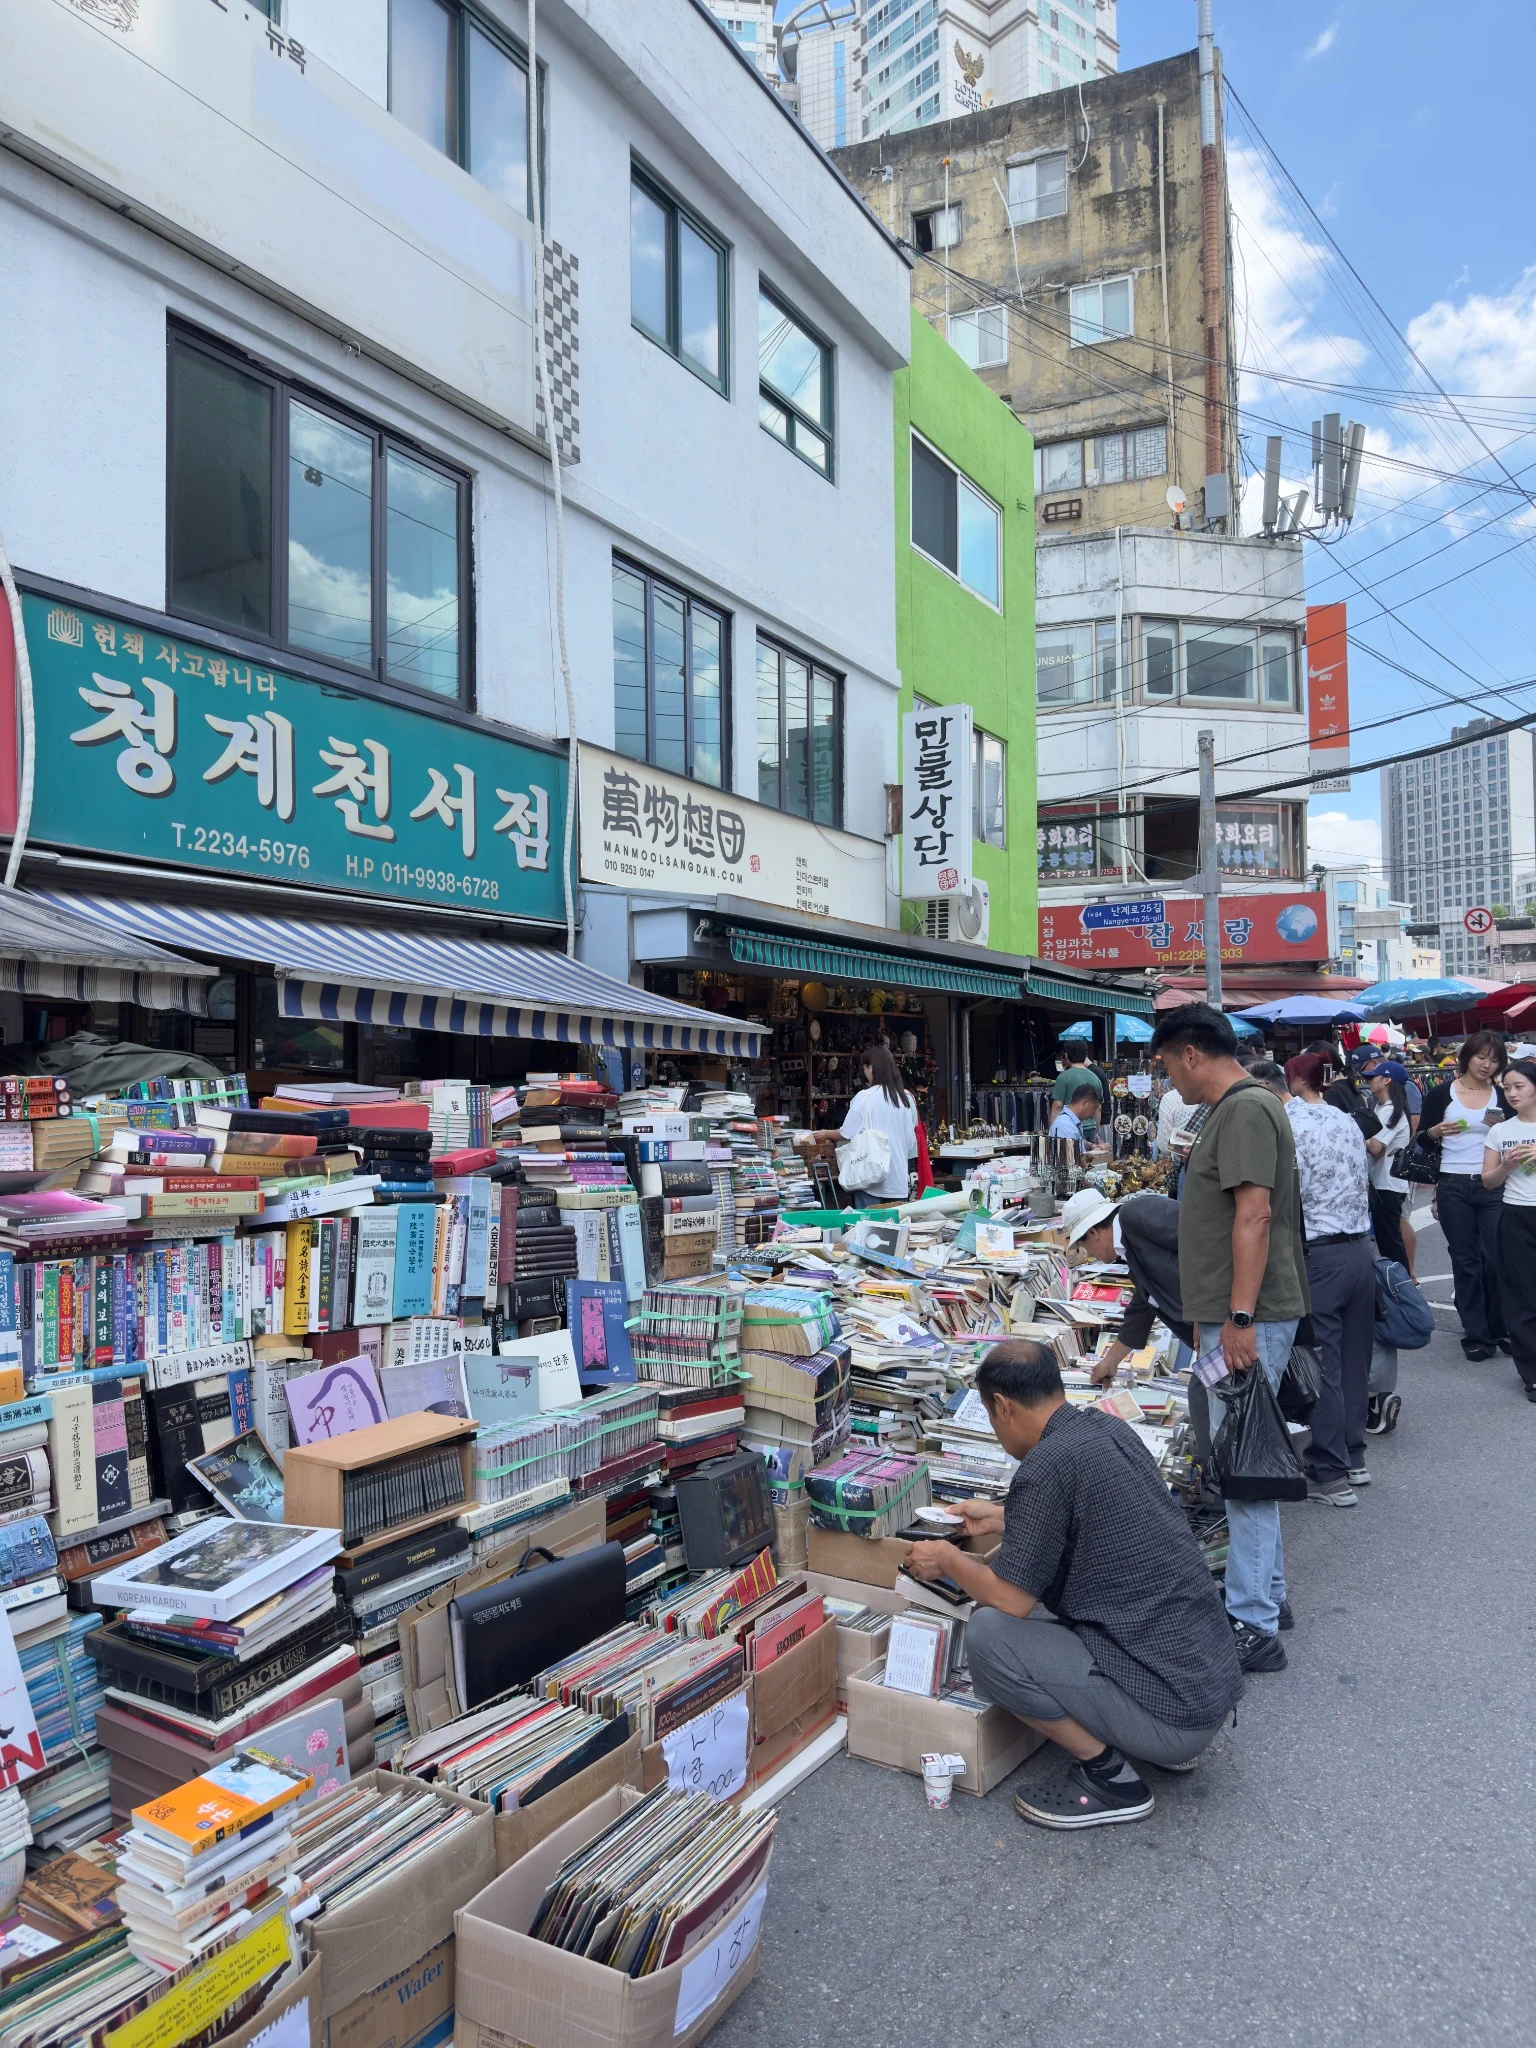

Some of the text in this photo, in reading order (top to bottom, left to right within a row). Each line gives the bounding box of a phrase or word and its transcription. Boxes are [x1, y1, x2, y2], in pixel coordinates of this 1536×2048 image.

[92, 622, 277, 701] 헌책 사고팝니다
[70, 672, 550, 872] 청계천서점
[1312, 780, 1349, 789] 2232-2828
[910, 717, 954, 866] 만물상단
[172, 822, 311, 870] T.2234-5976
[604, 841, 743, 884] MANMOOLSANGDAN.COM
[346, 853, 499, 900] H.P 011-9938-6728
[605, 859, 655, 879] 010 9253 0147
[1103, 915, 1162, 926] Nangye-ro 25-gil
[1042, 938, 1093, 949] 수입과자
[1042, 947, 1119, 961] 건강기능식품
[61, 1282, 72, 1315] 동의보감
[97, 1270, 108, 1341] 동의보감
[46, 1289, 57, 1362] 산야초 백과사전
[117, 1591, 187, 1610] KOREAN GARDEN
[283, 1644, 307, 1665] PIANO
[776, 1624, 807, 1656] BOBBY
[284, 1653, 307, 1673] MUSIC
[235, 1658, 283, 1702] BACH
[227, 1819, 244, 1833] 규슈
[227, 1886, 239, 1896] 다섯
[158, 1952, 246, 2021] JOHANN SEBASTIAN BACH
[397, 1960, 444, 2006] Wafer
